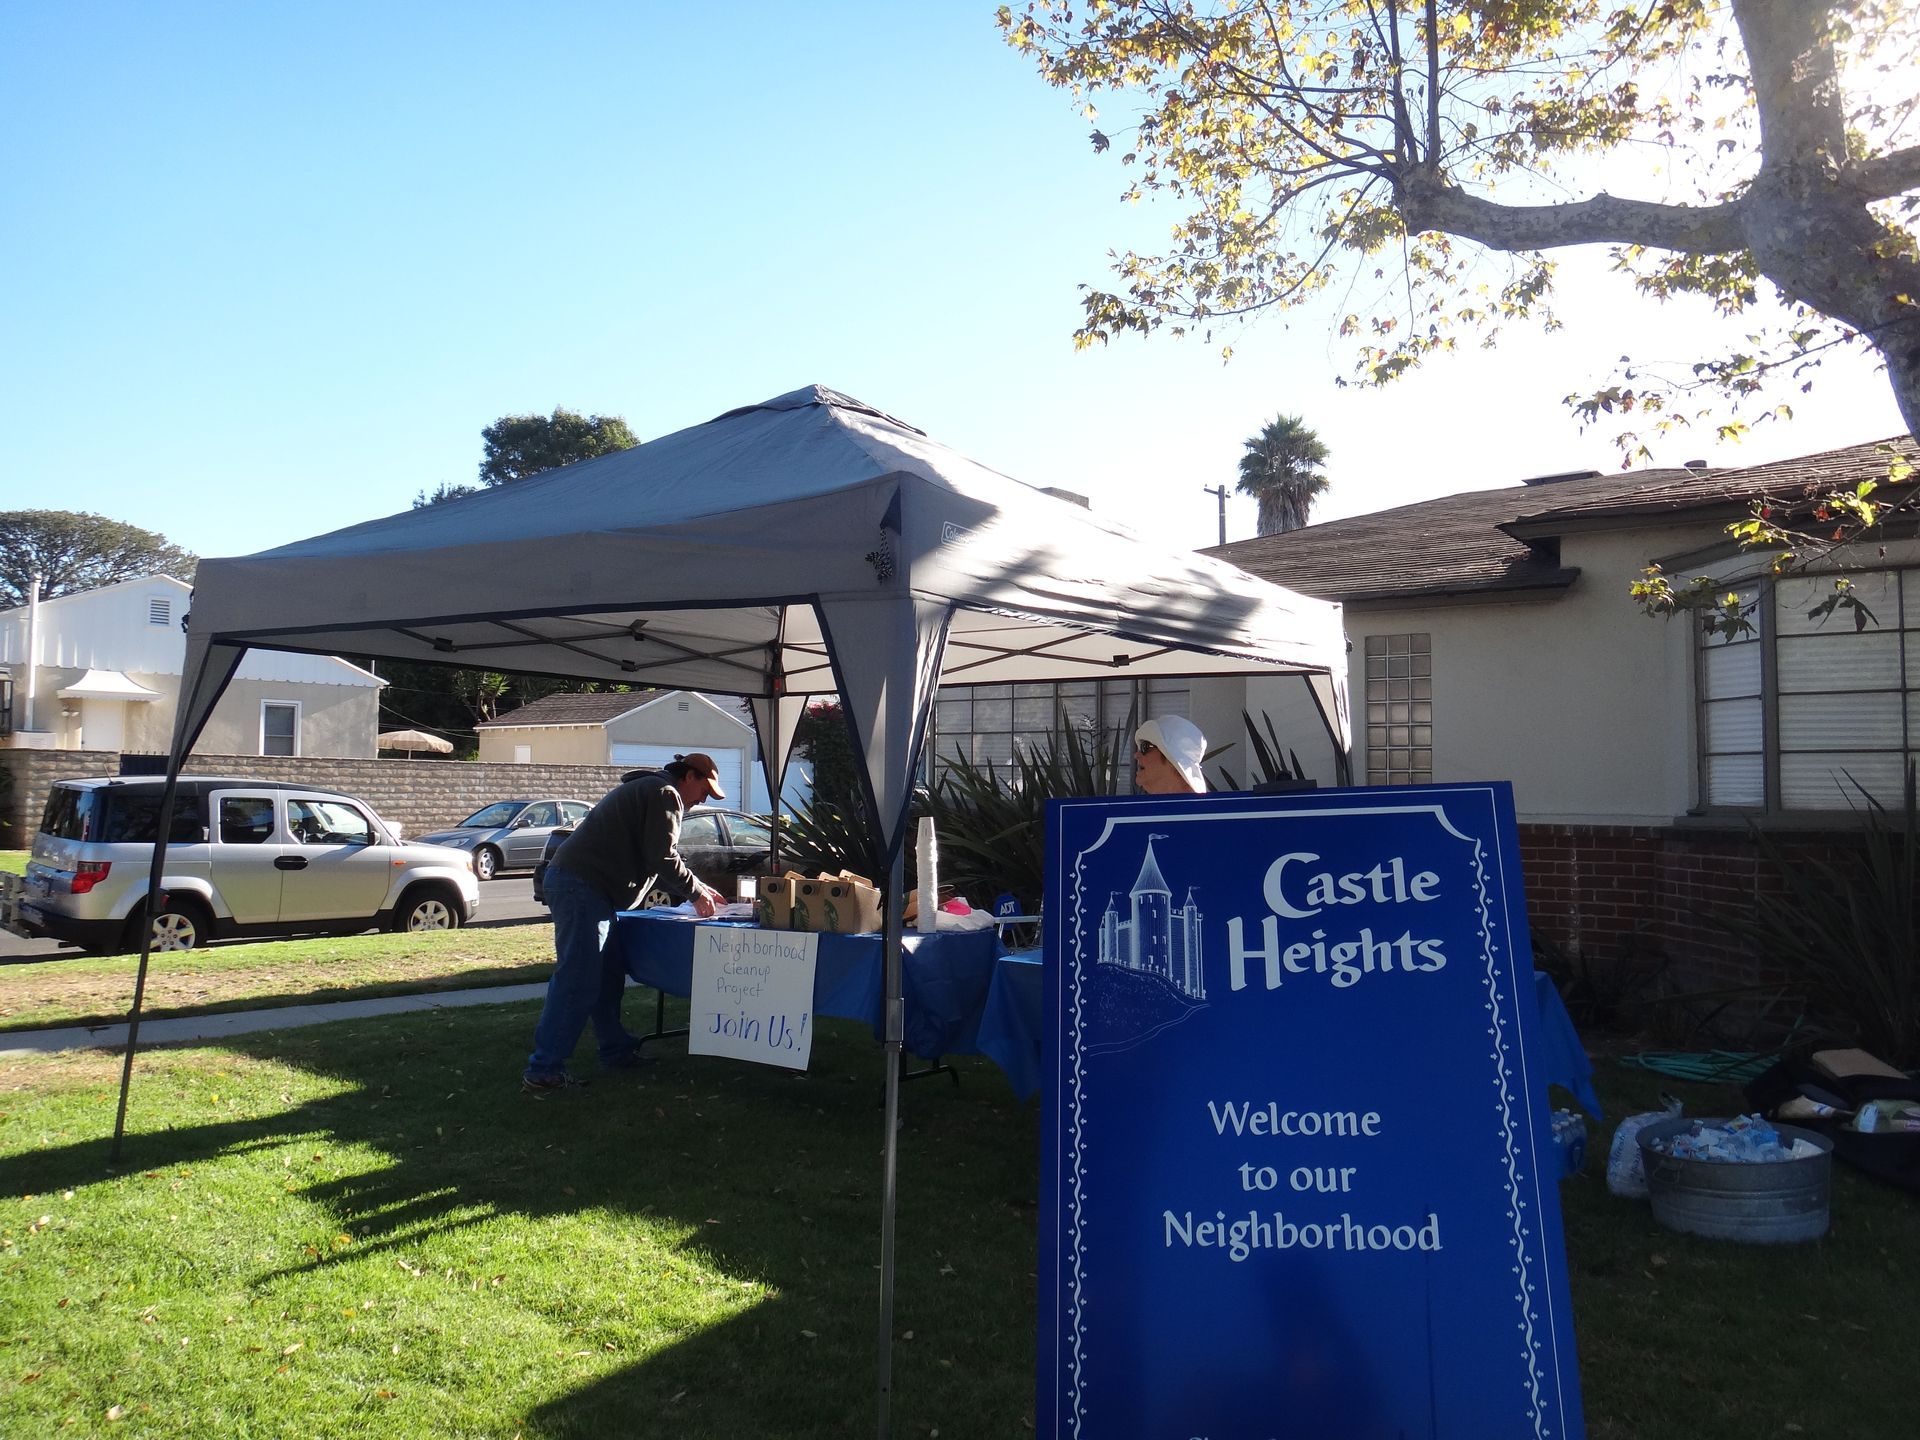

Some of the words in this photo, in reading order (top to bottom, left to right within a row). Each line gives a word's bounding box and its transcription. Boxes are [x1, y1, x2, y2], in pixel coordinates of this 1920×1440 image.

[1264, 852, 1441, 919] Castle
[1000, 901, 1015, 916] ADT
[709, 933, 808, 961] Neighborhood
[1227, 915, 1447, 992] Heights
[717, 977, 764, 1005] Project
[705, 1011, 760, 1042] Join
[769, 1013, 808, 1052] Us!
[1207, 1099, 1381, 1137] Welcome
[1238, 1161, 1278, 1191] to
[1290, 1167, 1357, 1193] our
[1163, 1209, 1443, 1262] Neighborhood
